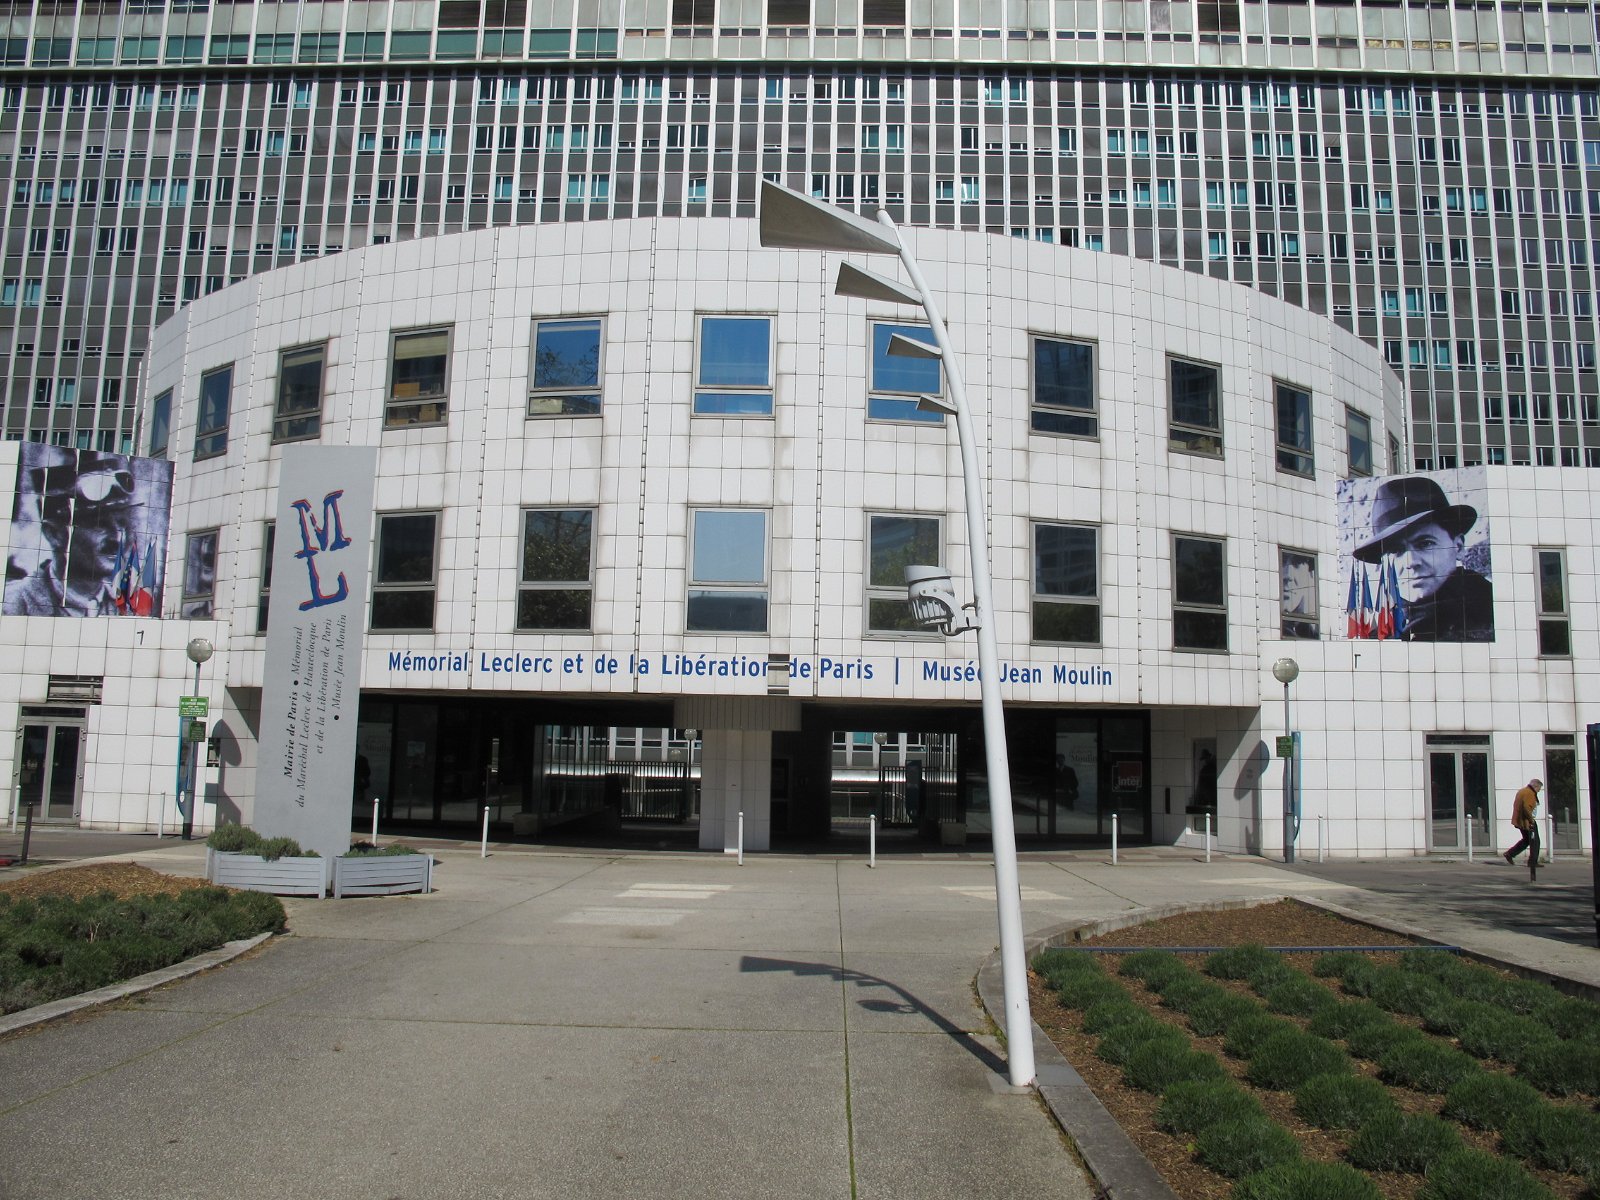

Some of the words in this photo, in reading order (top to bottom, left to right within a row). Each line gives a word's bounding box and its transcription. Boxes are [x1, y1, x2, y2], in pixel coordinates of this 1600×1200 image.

[321, 618, 332, 642] Paris
[335, 614, 347, 650] Moulin
[291, 626, 302, 675] Mémorial
[304, 622, 318, 687] Hauteclocque
[321, 646, 330, 658] de
[334, 654, 345, 677] Jean
[388, 651, 468, 672] Mémorial
[481, 652, 553, 673] Leclerc
[563, 653, 583, 674] et
[595, 654, 618, 674] de
[629, 653, 649, 675] la
[789, 657, 811, 678] de
[820, 658, 874, 680] Paris
[1000, 663, 1042, 684] Jean
[1053, 664, 1112, 686] Moulin
[302, 691, 312, 702] de
[317, 662, 329, 712] Libération
[331, 679, 342, 709] Musée
[287, 692, 298, 720] Paris
[286, 724, 296, 736] de
[299, 706, 311, 739] Leclerc
[315, 716, 325, 726] la
[315, 730, 324, 741] de
[316, 745, 323, 754] et
[284, 739, 294, 778] Mairie
[296, 743, 308, 790] Maréchal
[295, 794, 305, 808] du
